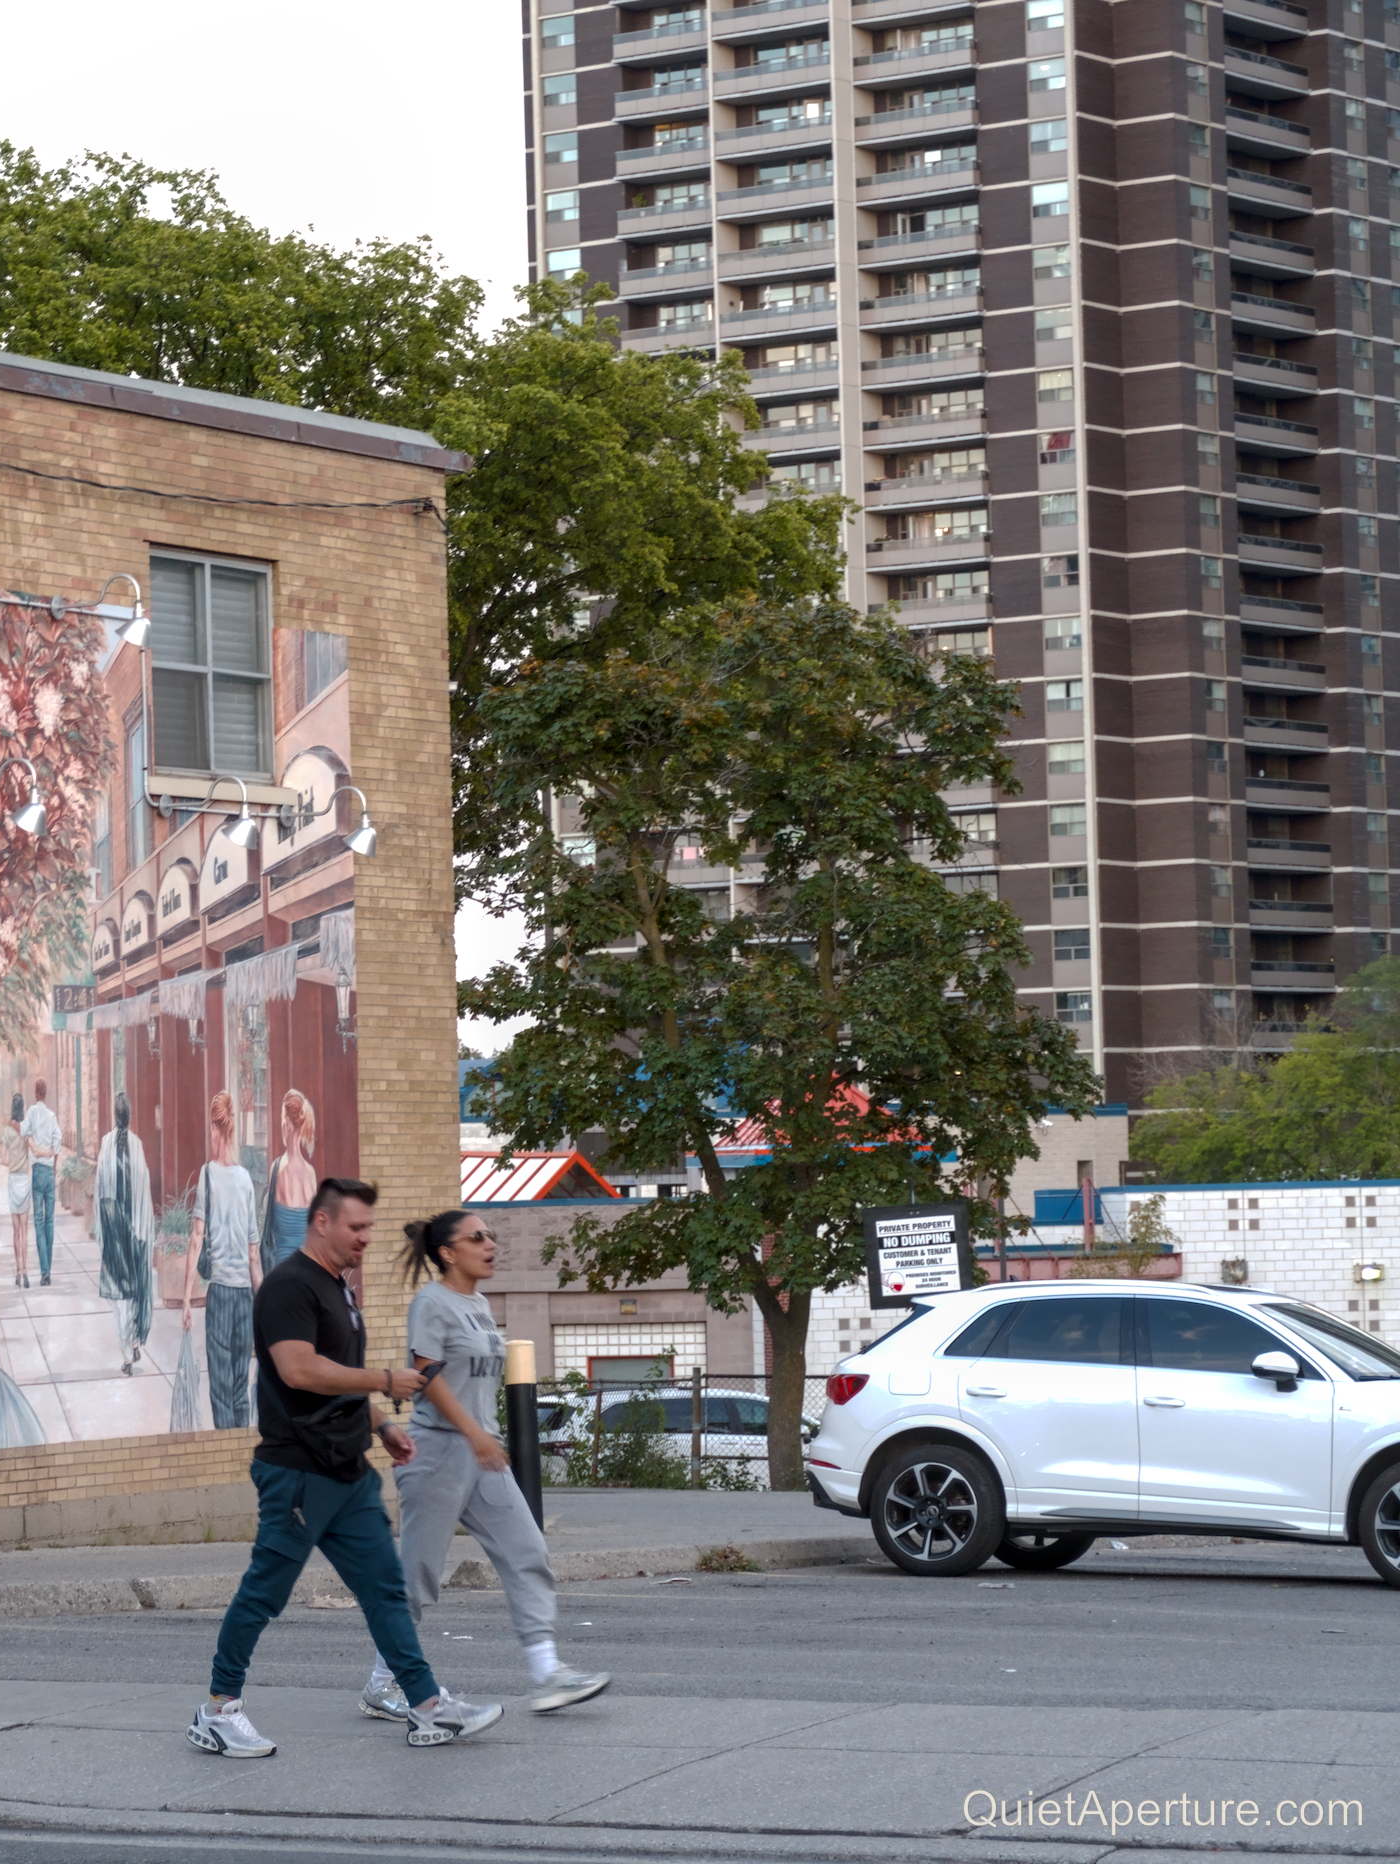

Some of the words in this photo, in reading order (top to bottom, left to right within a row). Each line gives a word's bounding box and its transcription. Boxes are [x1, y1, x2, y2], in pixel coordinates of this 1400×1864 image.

[878, 1223, 910, 1233] PRIVATE
[912, 1220, 951, 1230] PROPERTY
[883, 1236, 899, 1248] NO
[901, 1232, 951, 1246] DUMPING
[883, 1250, 918, 1259] CUSTOMER
[927, 1247, 952, 1256] TENANT
[896, 1258, 925, 1267] PARKING
[926, 1257, 943, 1266] ONLY
